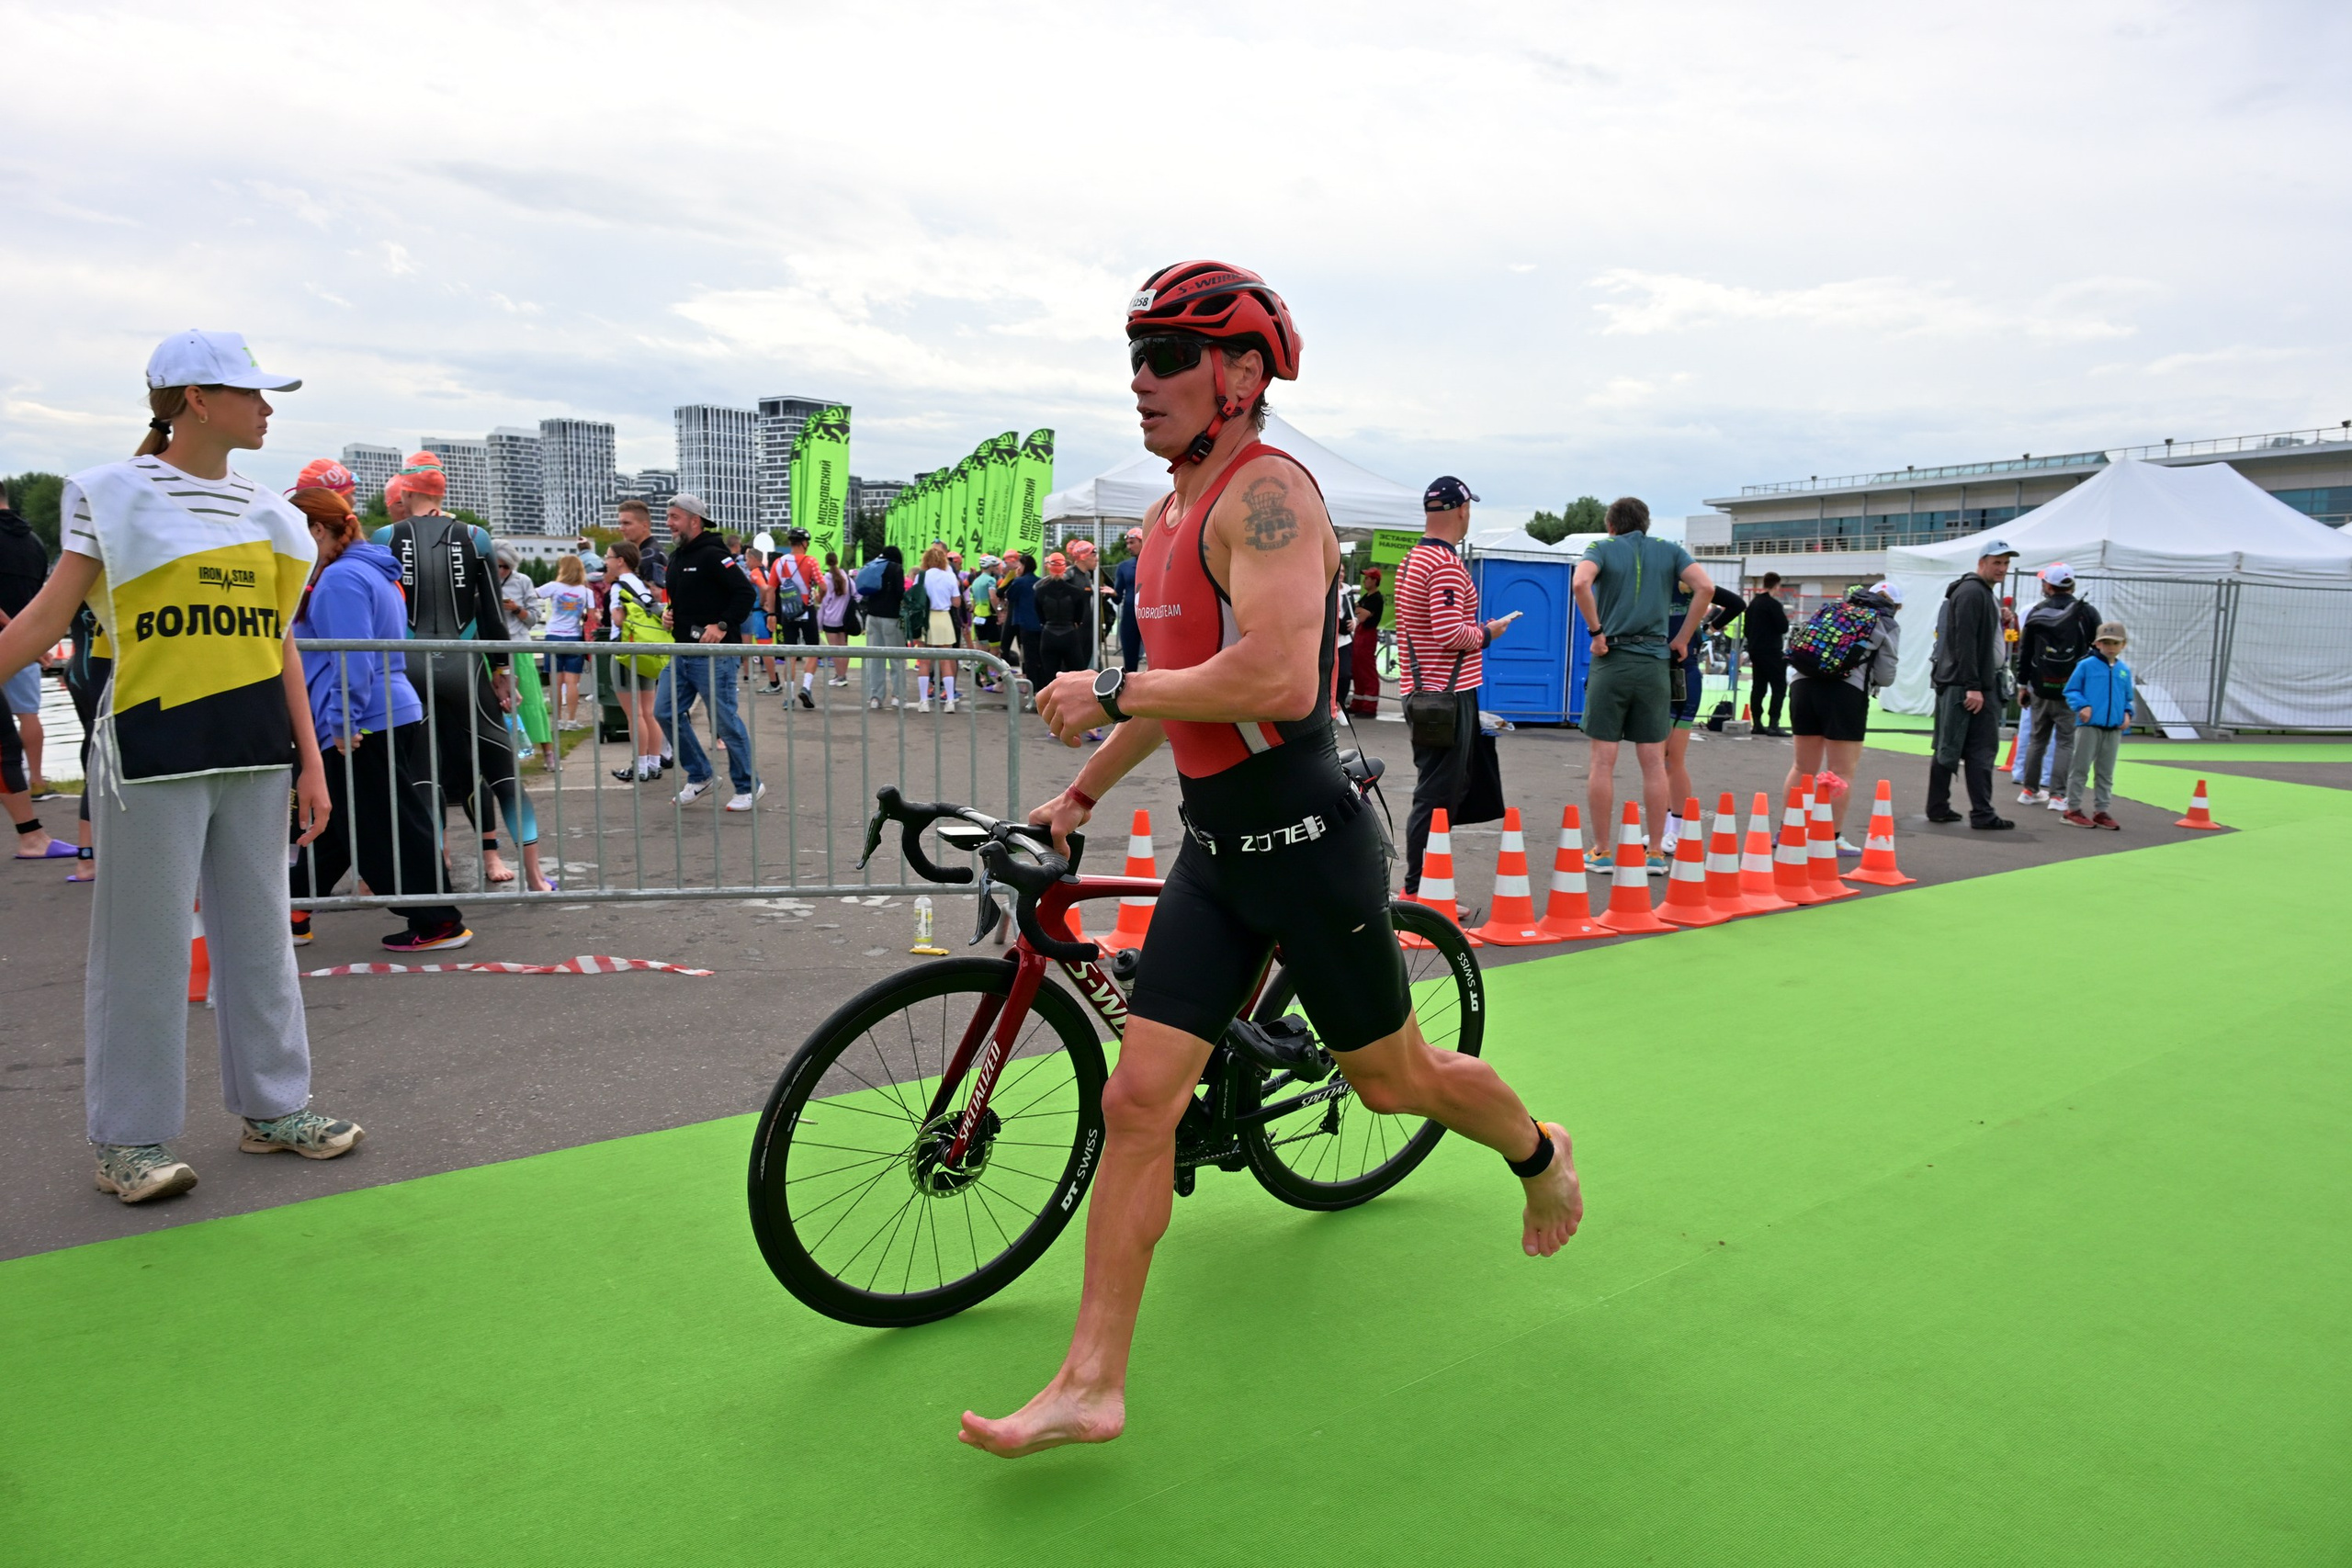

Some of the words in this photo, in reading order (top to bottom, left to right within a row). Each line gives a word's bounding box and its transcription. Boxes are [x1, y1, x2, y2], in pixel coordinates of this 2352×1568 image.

[817, 459, 831, 525] МОСКОВСКИЙ
[1019, 477, 1036, 541] МОСКОВСКИЙ
[827, 496, 841, 527] СПОРТ
[1030, 513, 1043, 543] СПОРТ
[198, 566, 222, 580] IRON
[232, 570, 255, 583] STAR
[401, 539, 413, 586] HUUB
[1442, 589, 1455, 606] 3
[1457, 953, 1476, 987] SWISS
[1469, 990, 1479, 1011] DT
[959, 1040, 1001, 1145] SPECIALIZED
[1060, 1180, 1079, 1212] DT
[1076, 1128, 1098, 1180] SWISS
